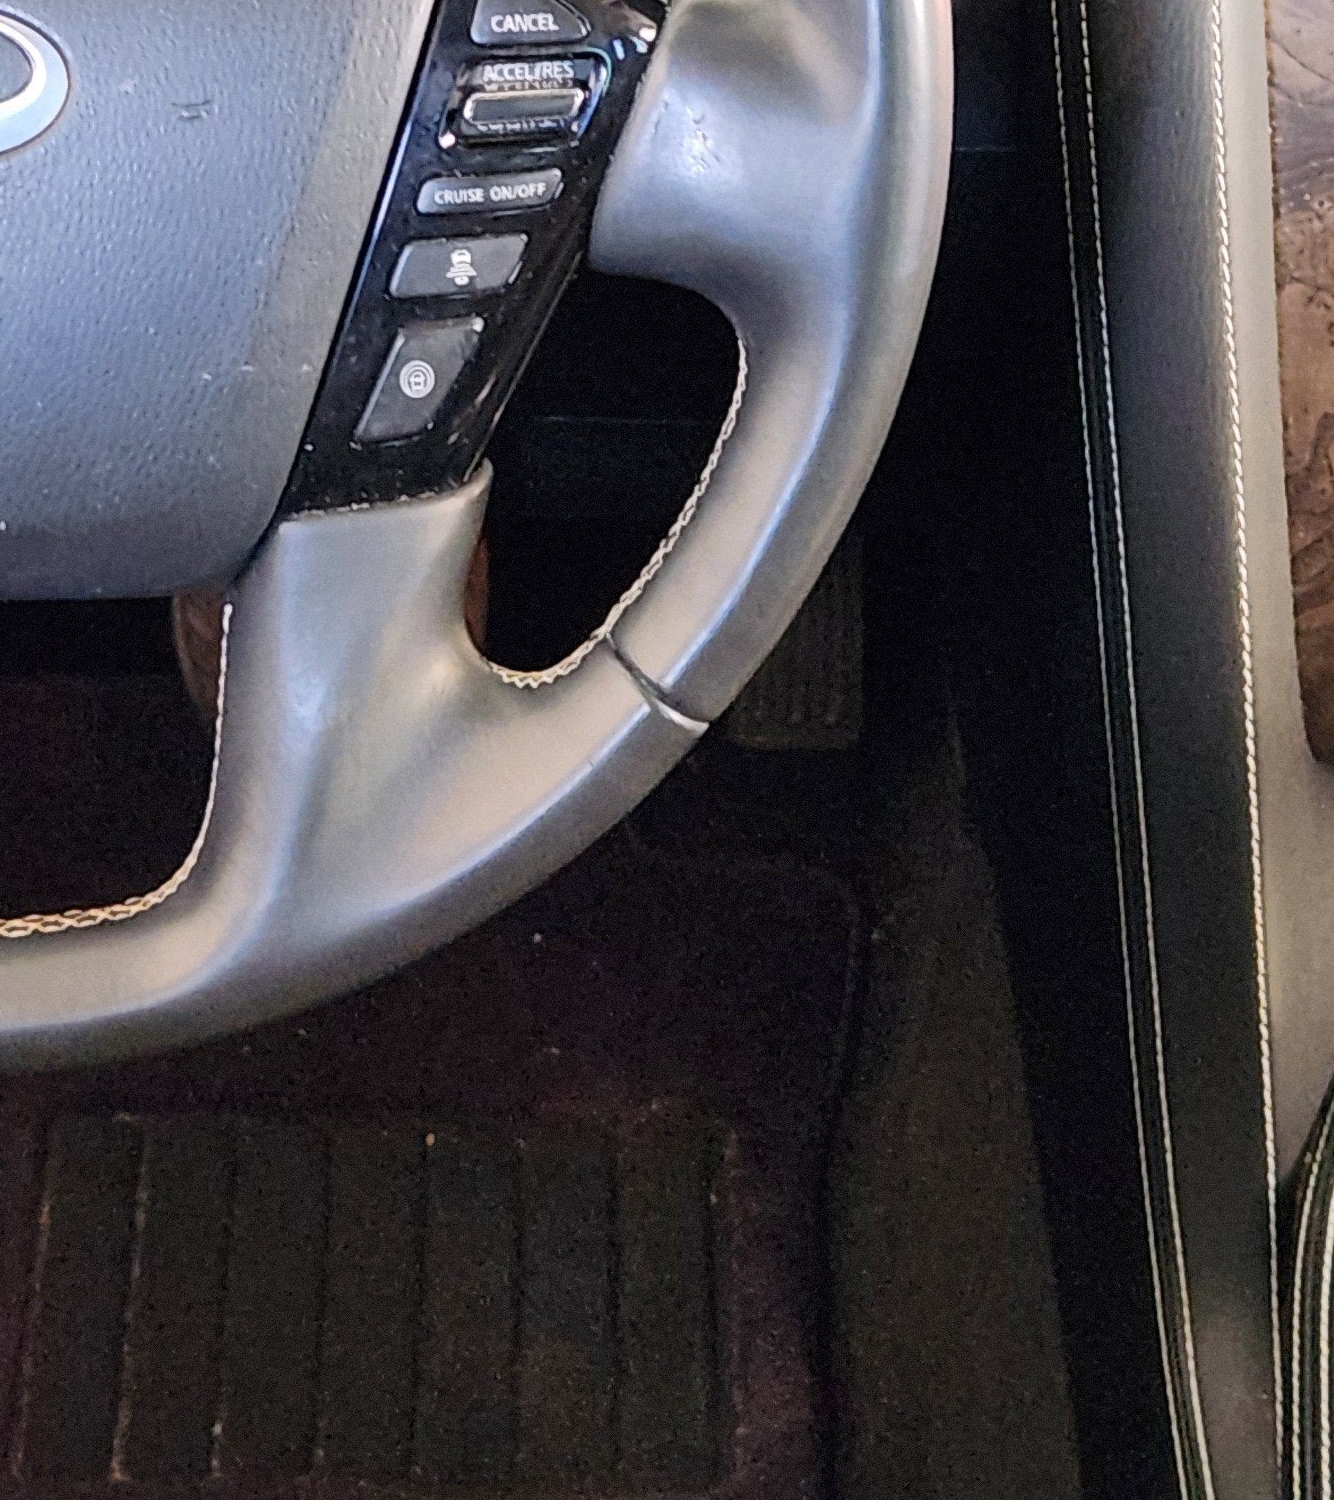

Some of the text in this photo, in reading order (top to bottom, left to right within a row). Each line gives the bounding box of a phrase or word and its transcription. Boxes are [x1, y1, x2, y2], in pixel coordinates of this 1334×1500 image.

[490, 12, 560, 34] CANCEL
[433, 180, 548, 204] CRUISE ON/OFF
